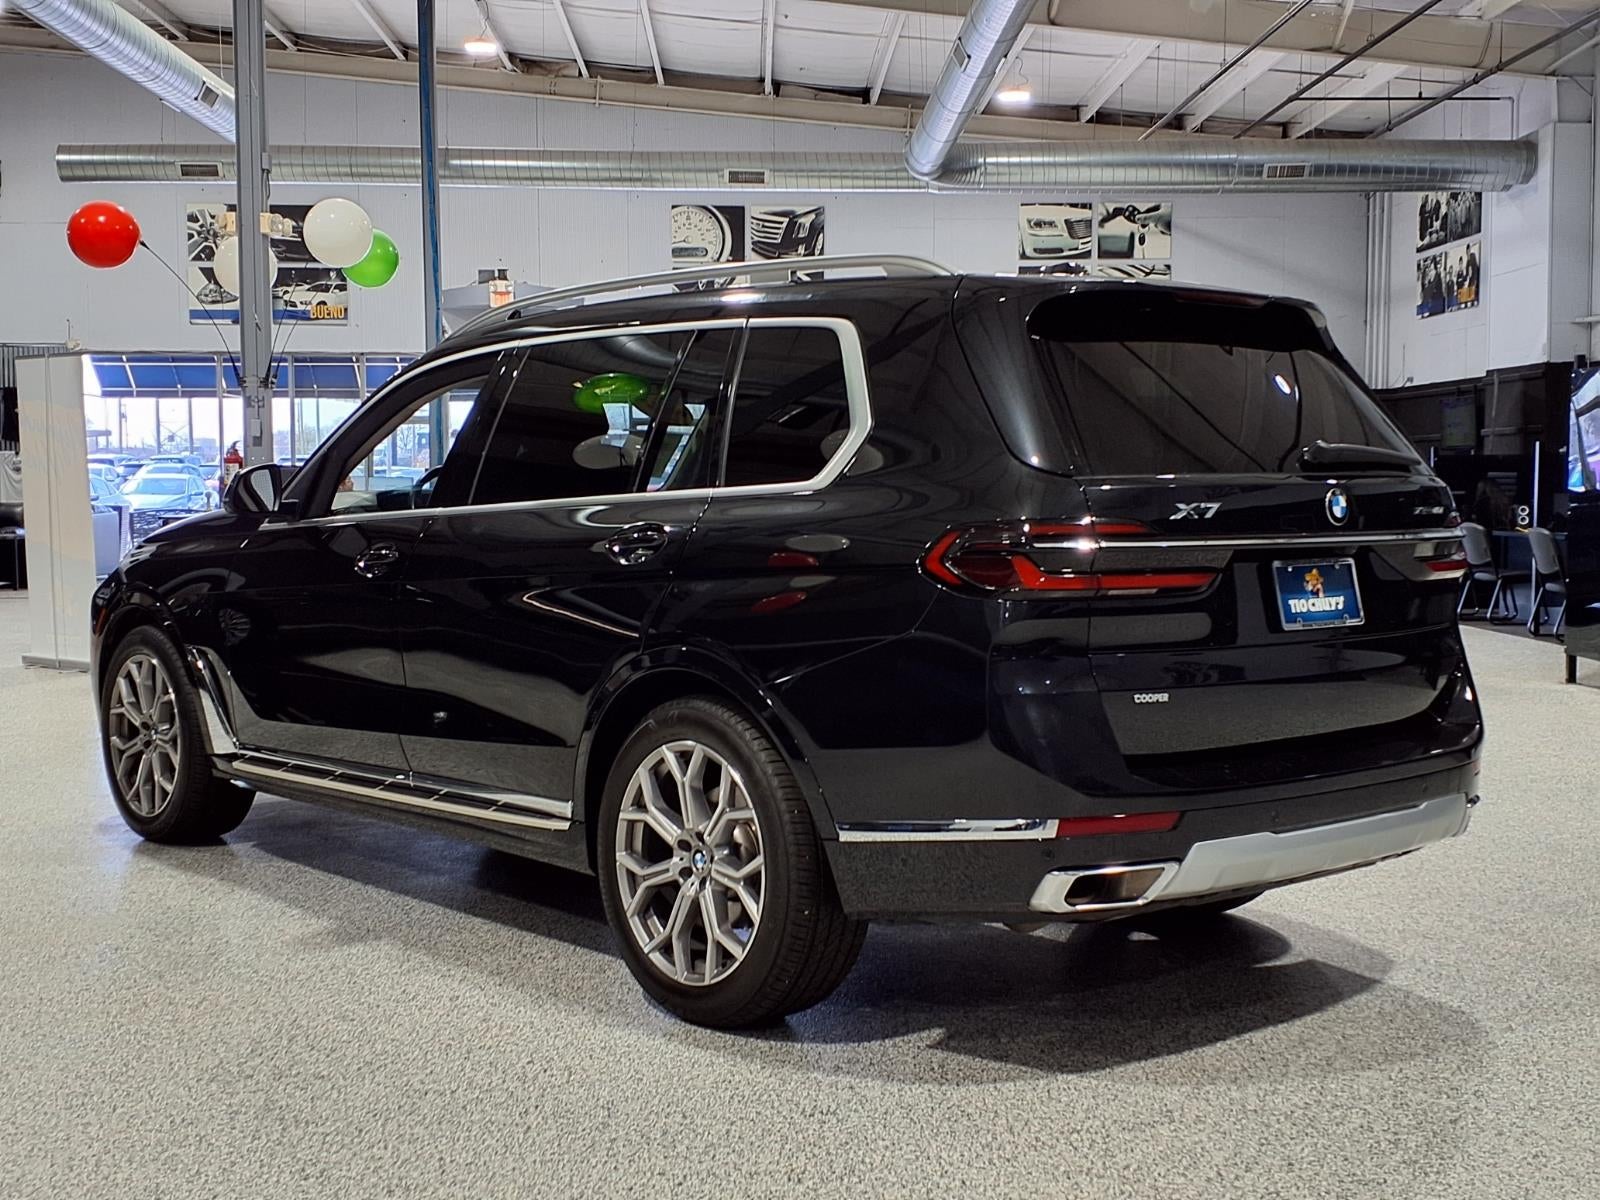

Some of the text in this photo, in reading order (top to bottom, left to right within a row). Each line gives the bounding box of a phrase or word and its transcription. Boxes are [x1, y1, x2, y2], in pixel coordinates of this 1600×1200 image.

[310, 305, 345, 319] BUENO
[1169, 502, 1222, 520] X7
[1288, 598, 1308, 613] TIO
[1133, 692, 1169, 704] COOPER
